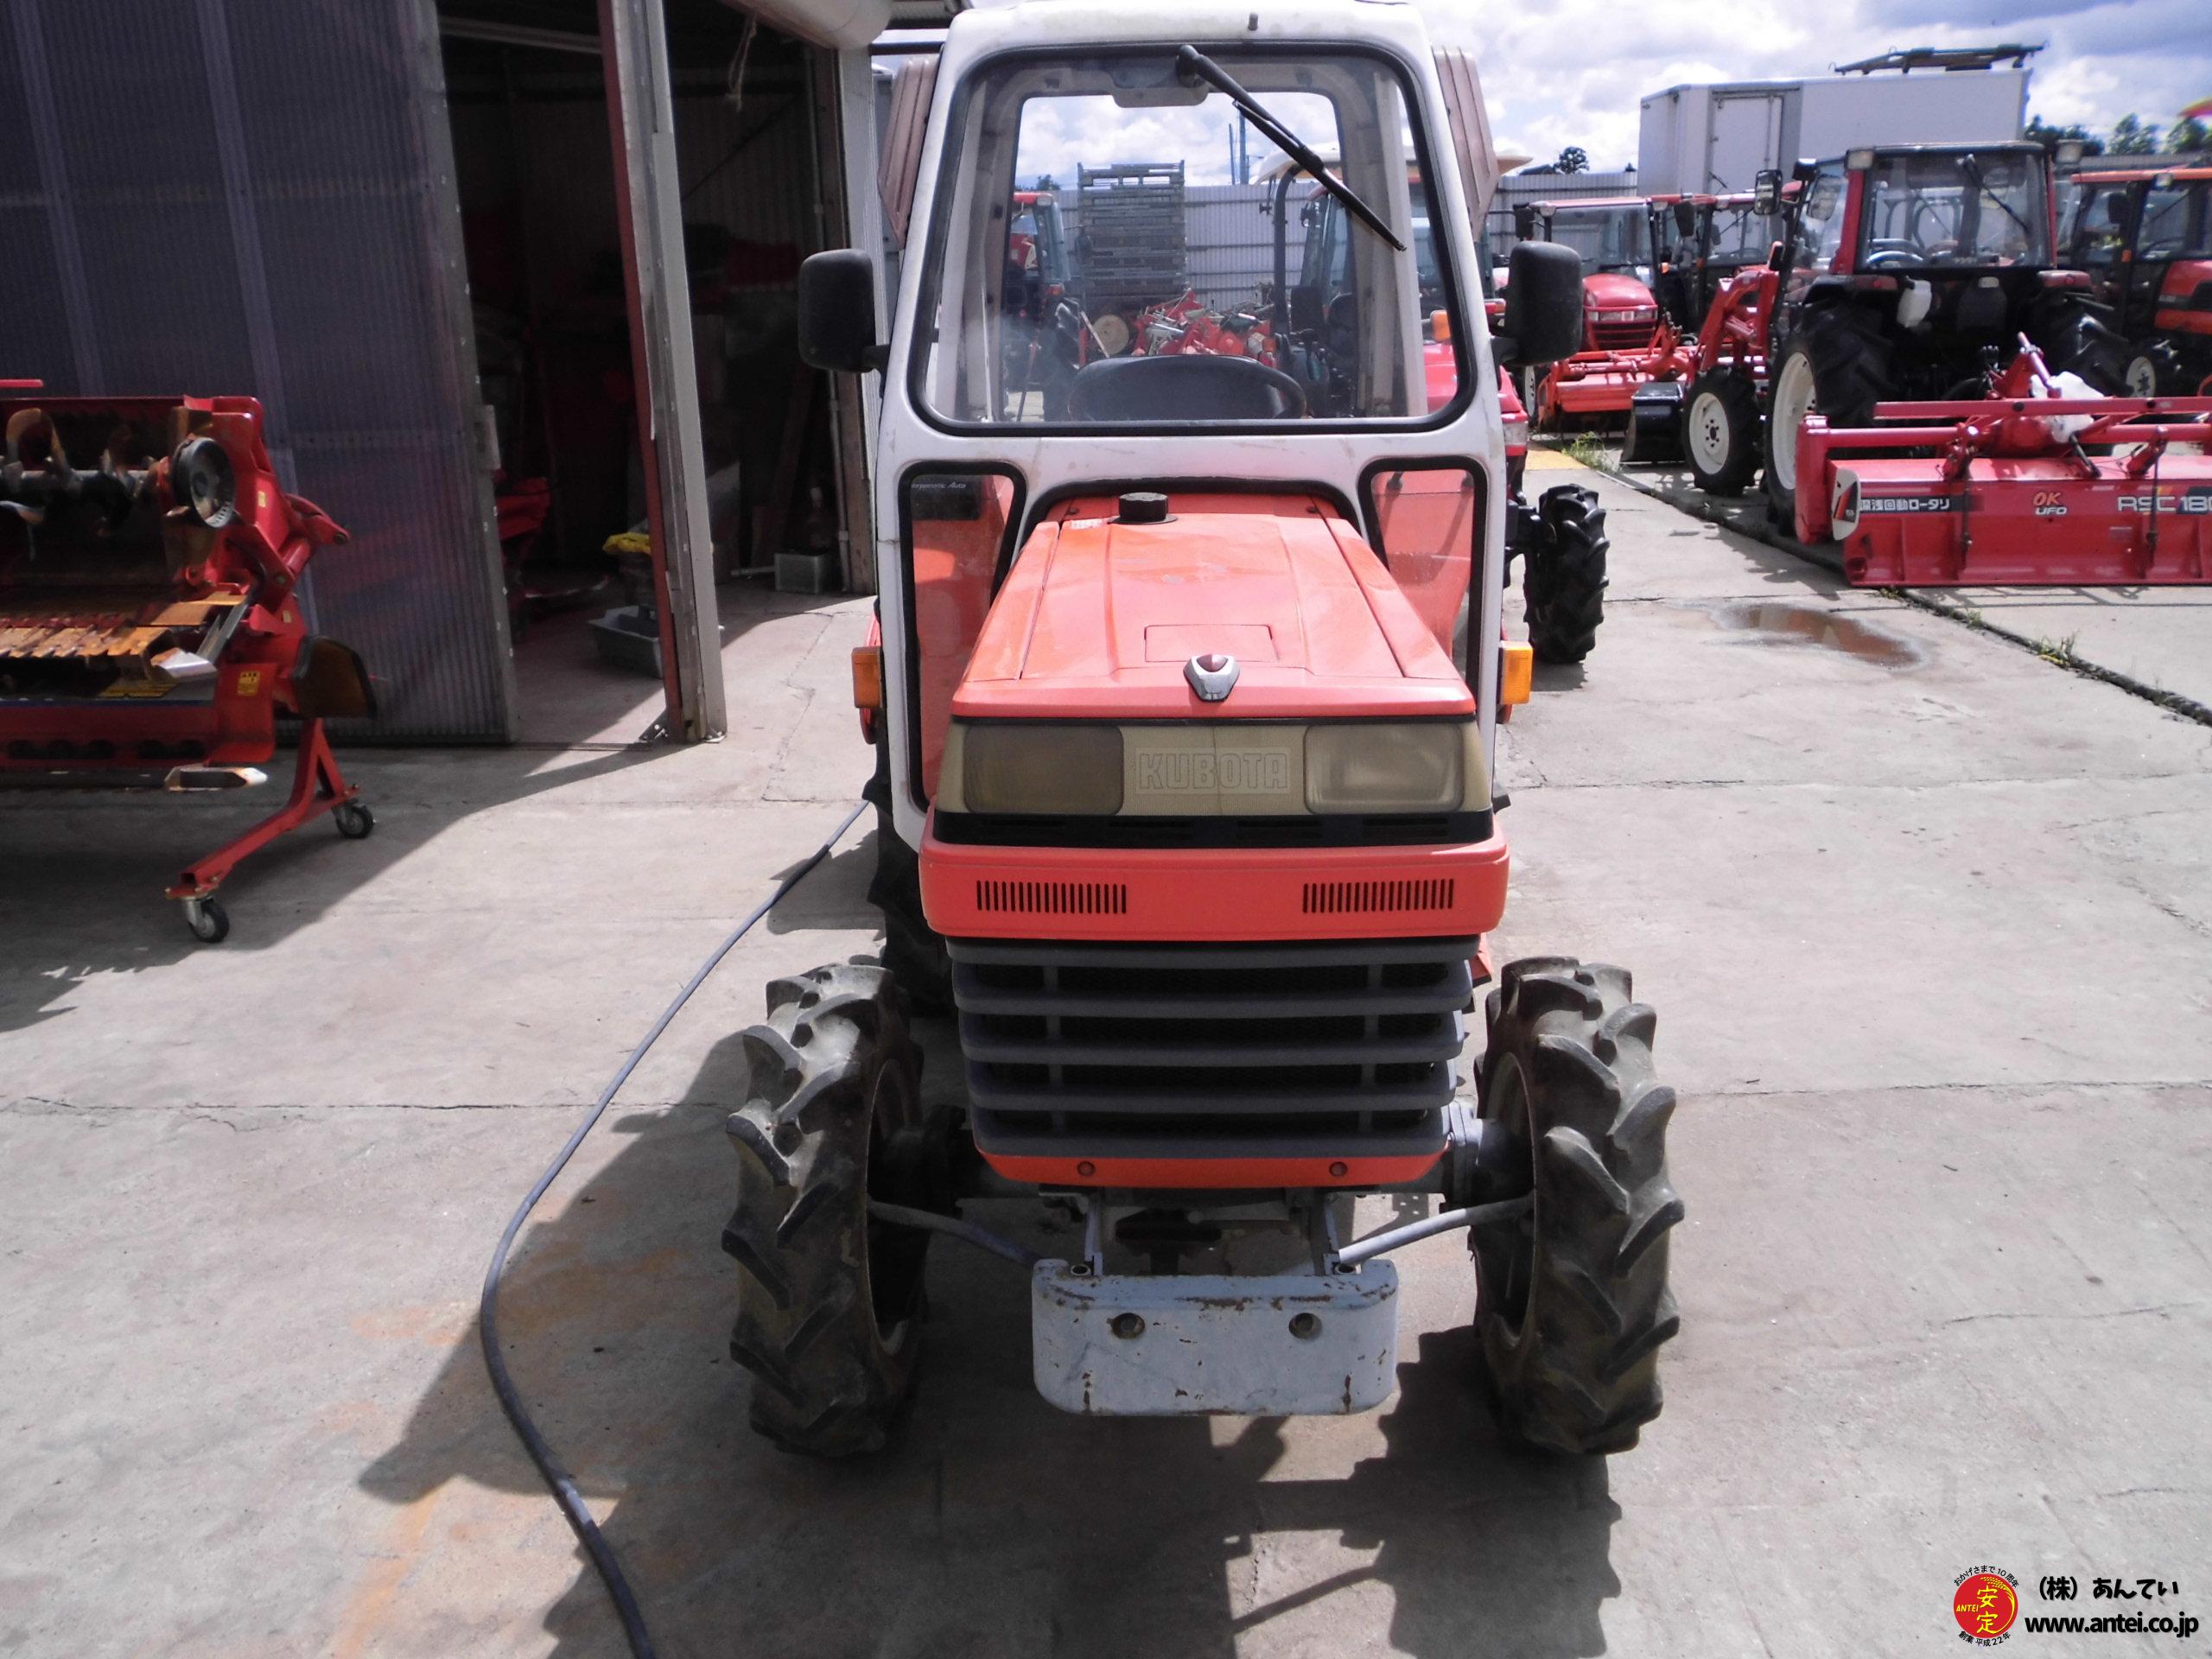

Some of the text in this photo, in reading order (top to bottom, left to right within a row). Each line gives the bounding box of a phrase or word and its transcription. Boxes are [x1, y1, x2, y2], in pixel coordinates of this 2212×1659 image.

[2033, 492, 2062, 506] OK
[2180, 496, 2212, 512] 18
[2035, 506, 2067, 515] UFO
[1139, 753, 1287, 790] KUBOTA
